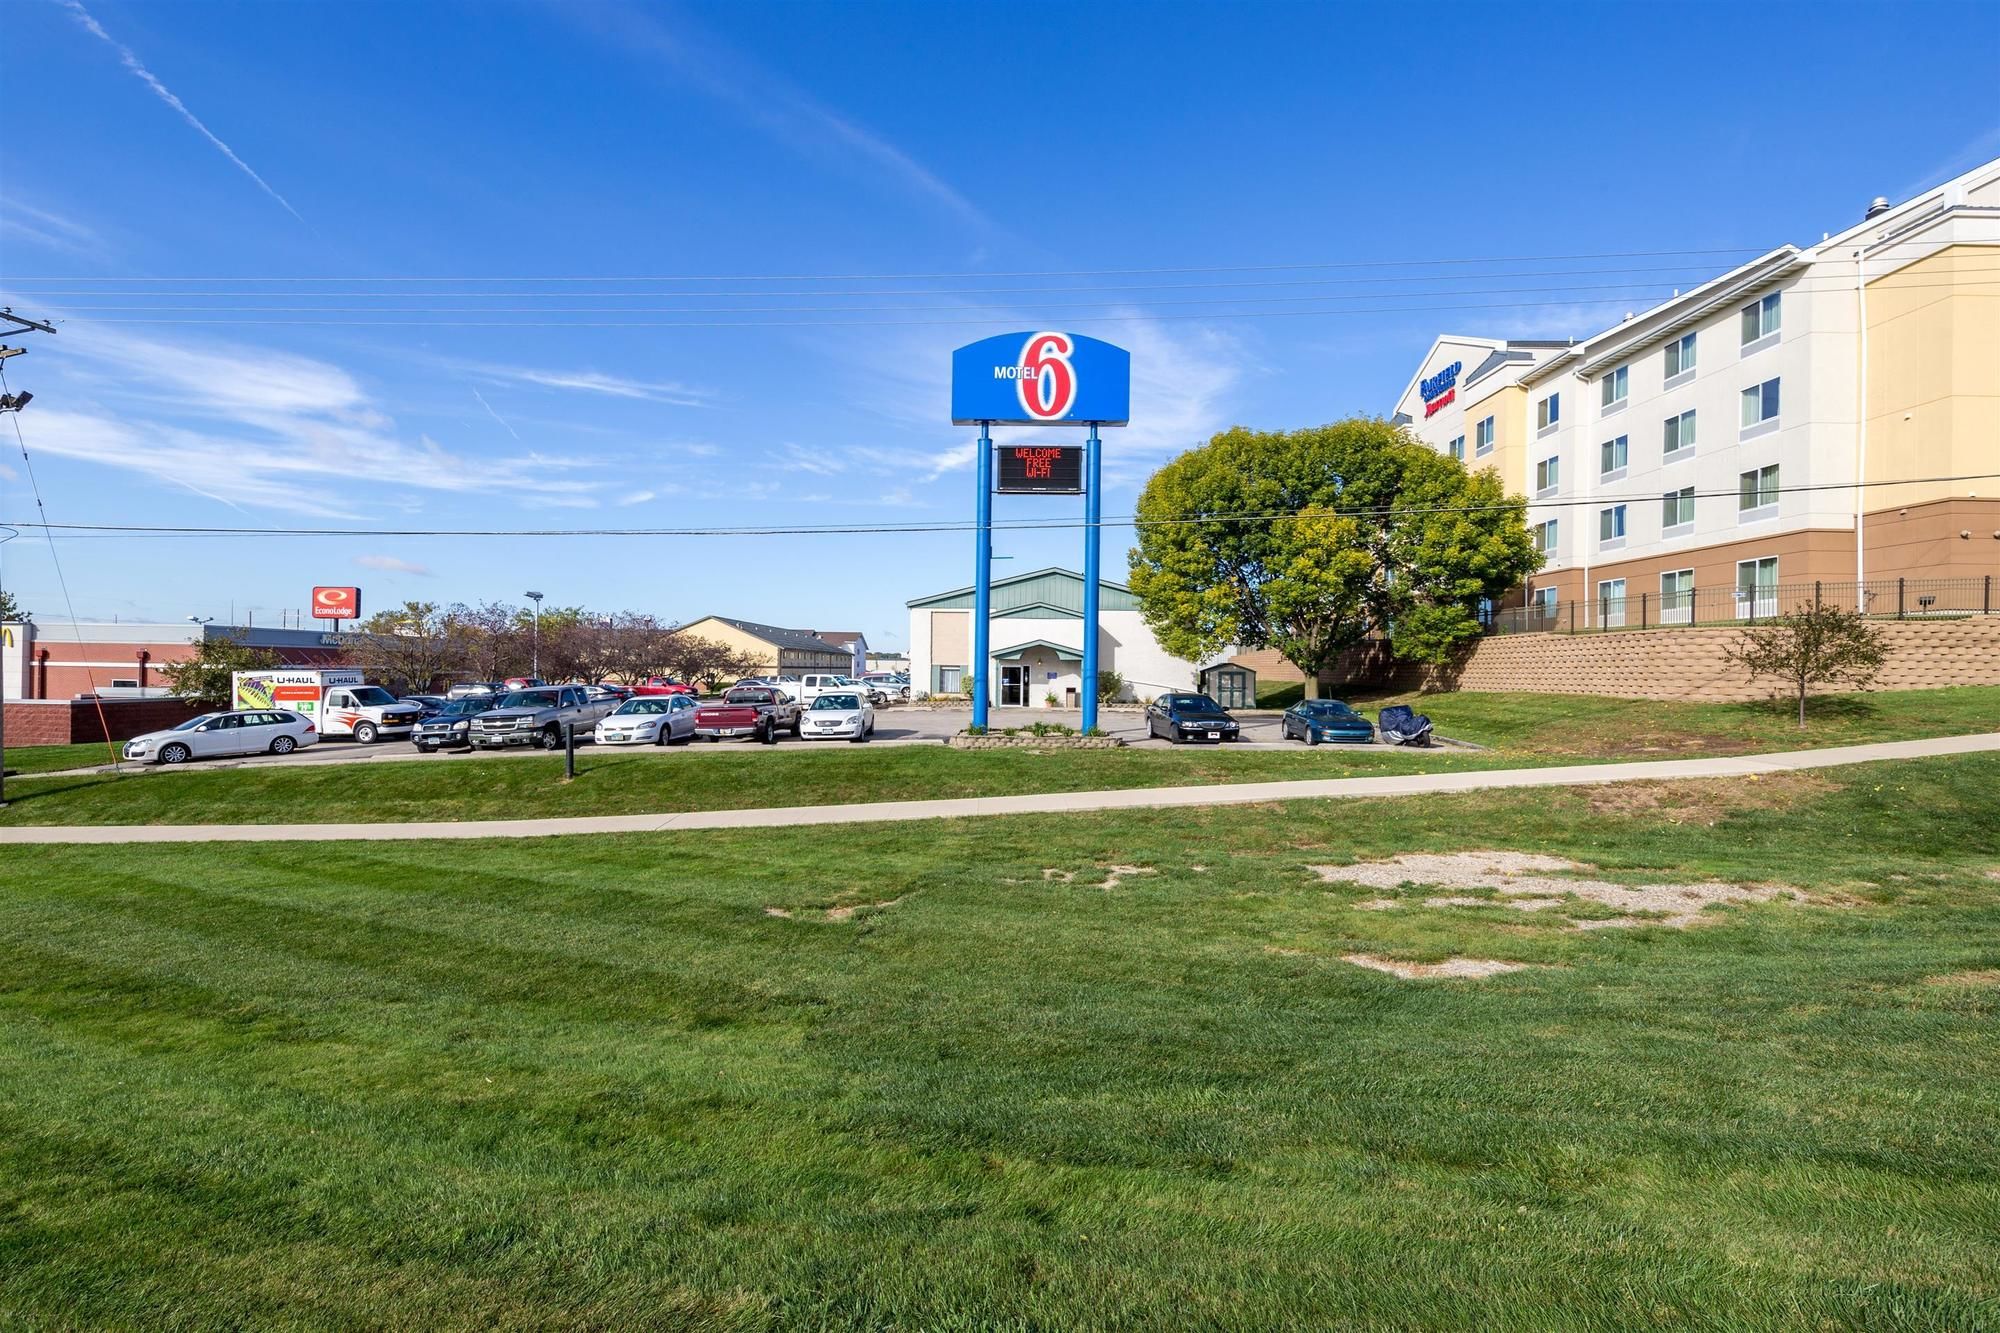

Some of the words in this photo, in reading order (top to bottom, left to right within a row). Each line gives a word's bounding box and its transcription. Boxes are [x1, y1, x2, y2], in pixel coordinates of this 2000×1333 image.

[994, 366, 1038, 379] MOTEL
[1018, 332, 1076, 419] 6
[1015, 448, 1062, 459] WELCOME
[1026, 458, 1052, 468] FREE
[1026, 468, 1051, 478] WI-FI
[276, 676, 315, 684] U-HAUL
[328, 676, 359, 684] U-HAUL
